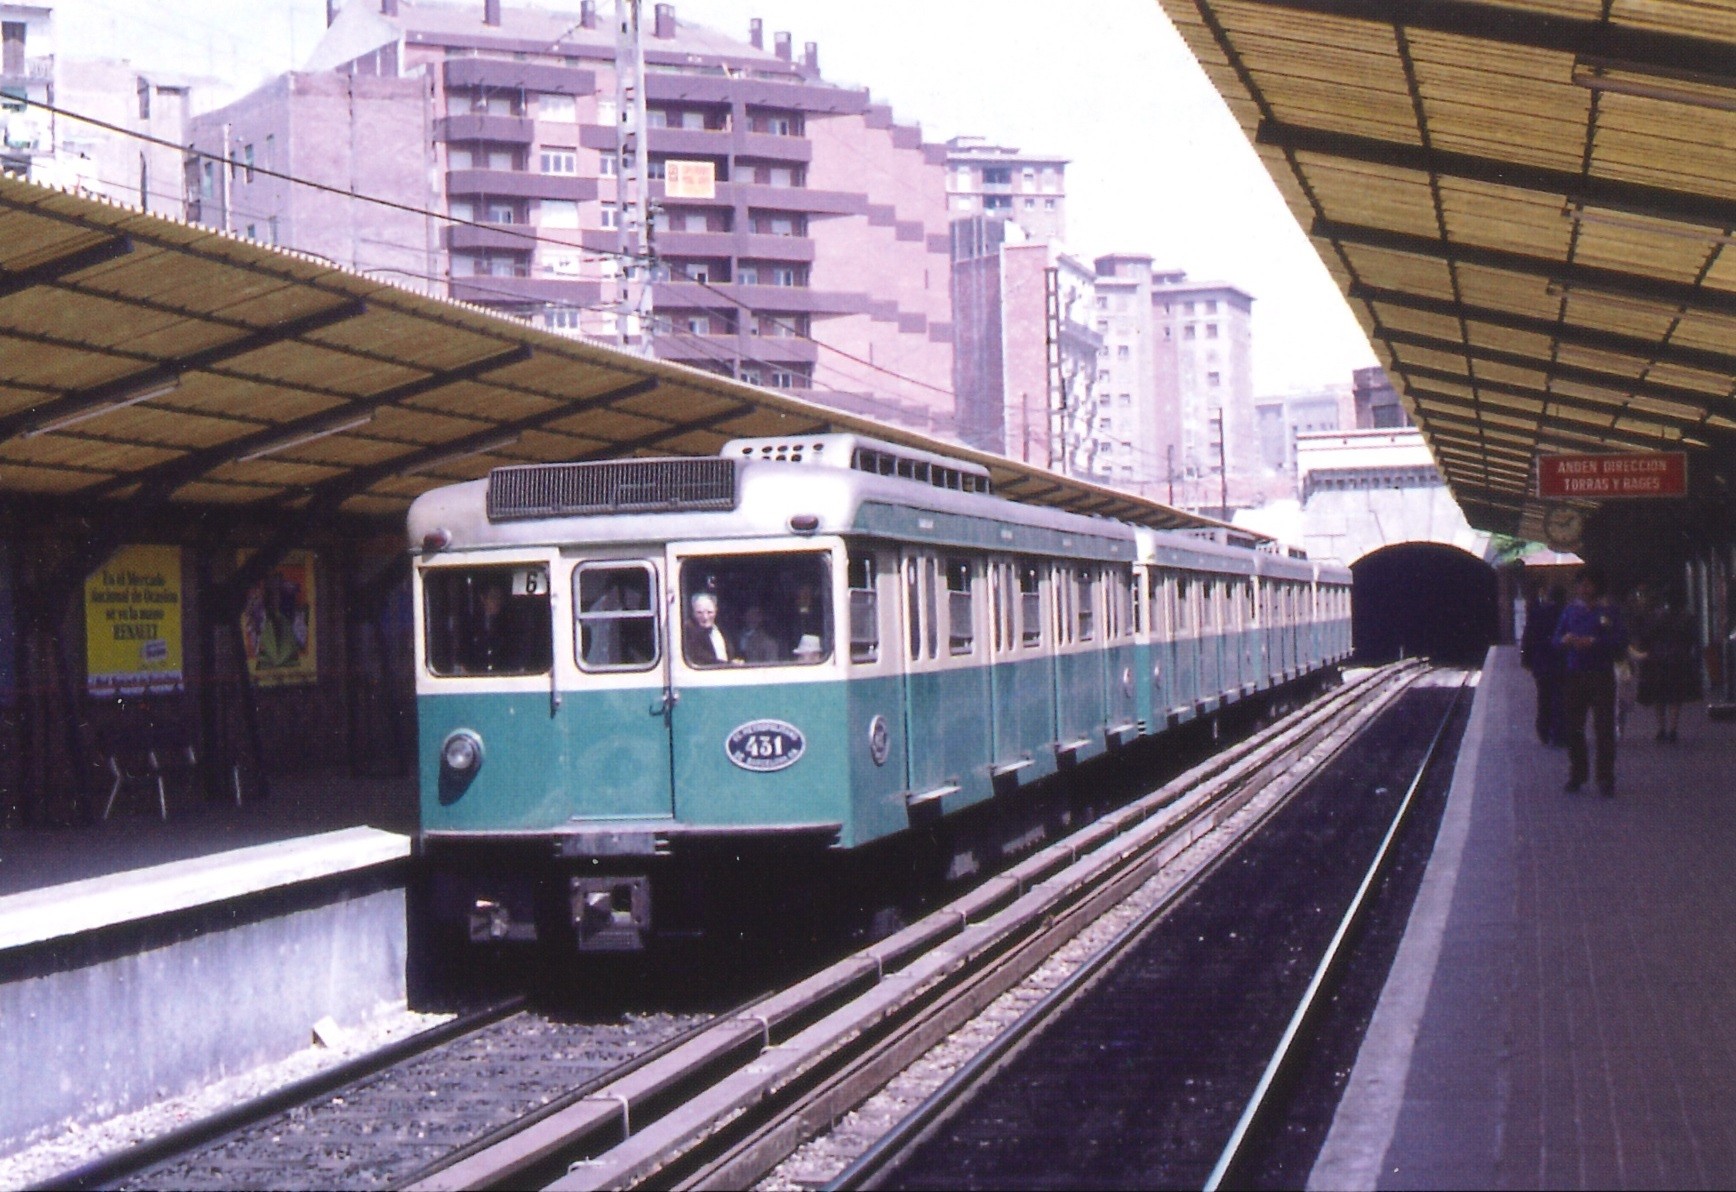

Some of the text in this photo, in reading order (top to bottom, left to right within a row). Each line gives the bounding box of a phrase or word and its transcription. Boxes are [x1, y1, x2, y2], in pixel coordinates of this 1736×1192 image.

[1557, 458, 1668, 474] ANDEN DIRECCION
[1564, 476, 1661, 491] TORRAS Y BAGES
[127, 570, 166, 586] Mercado
[526, 570, 538, 593] 6
[114, 624, 157, 640] RENAULT
[745, 735, 783, 757] 431
